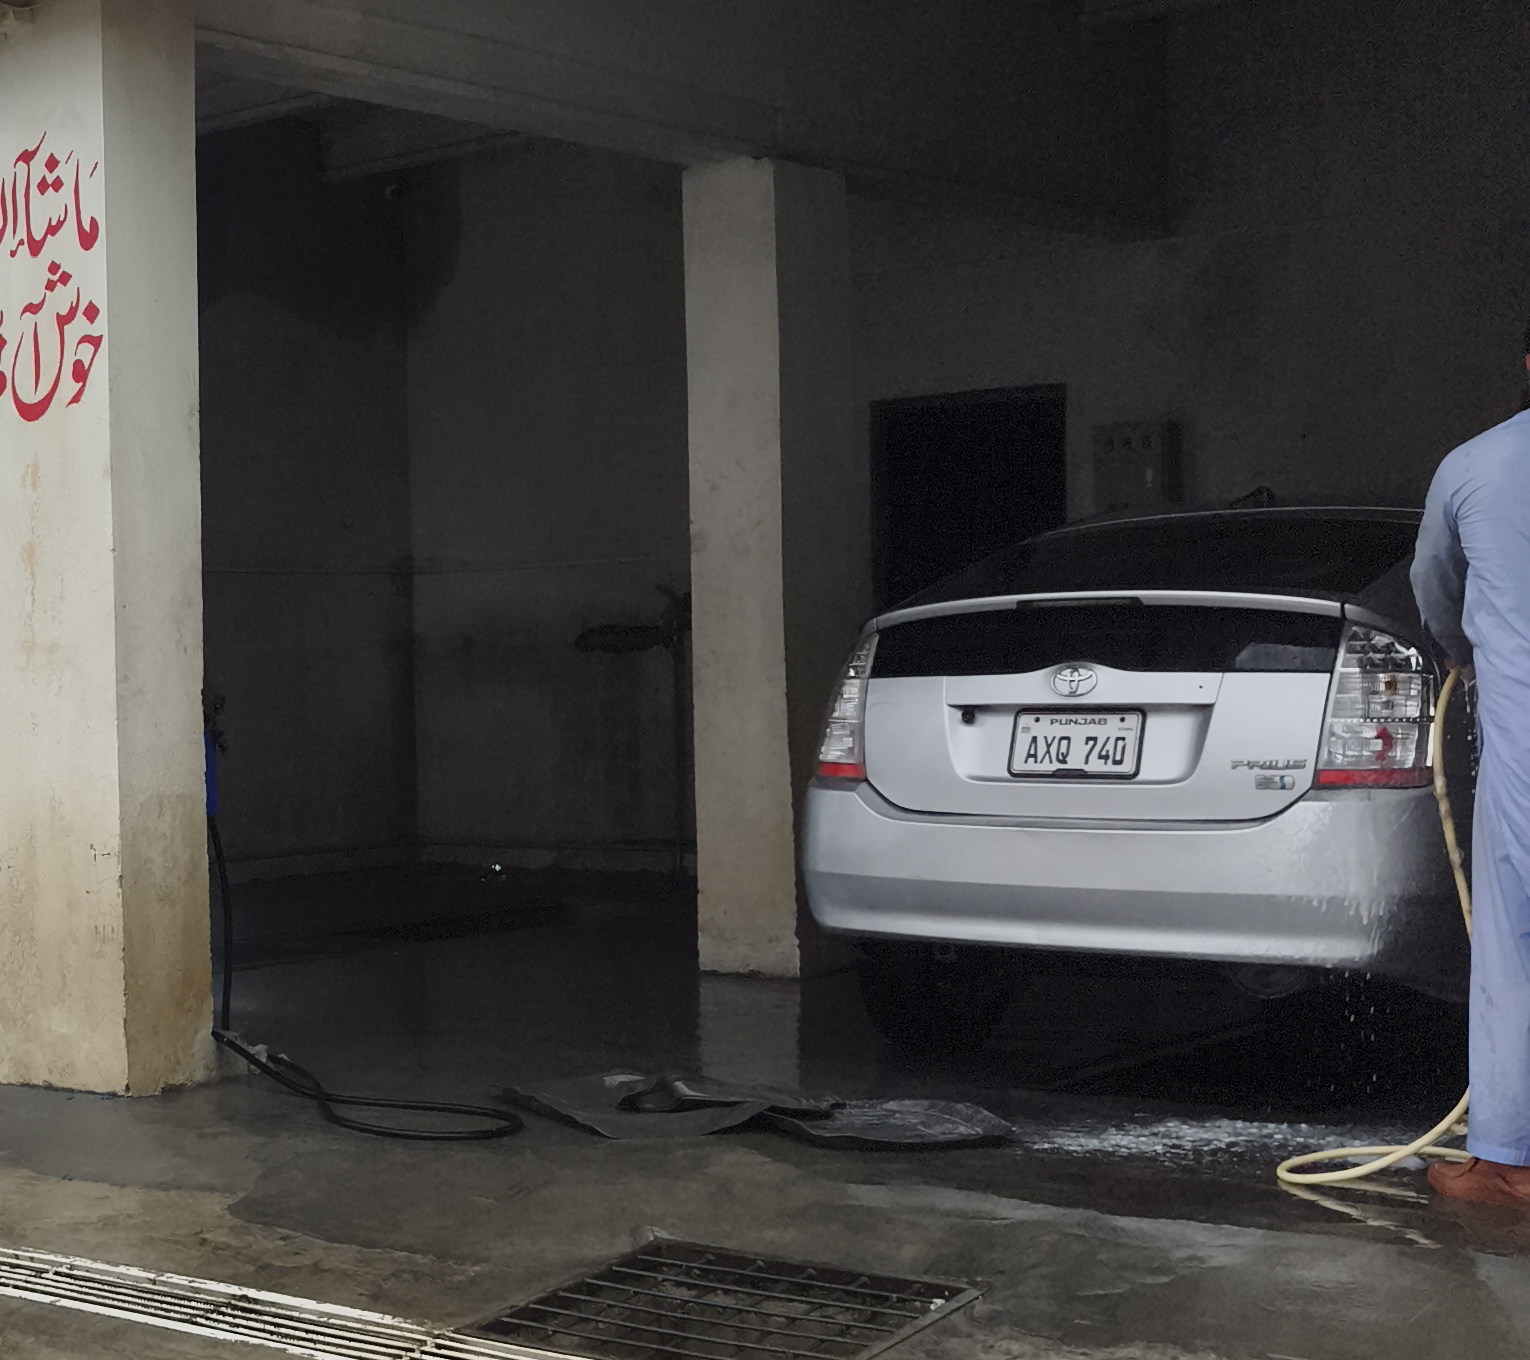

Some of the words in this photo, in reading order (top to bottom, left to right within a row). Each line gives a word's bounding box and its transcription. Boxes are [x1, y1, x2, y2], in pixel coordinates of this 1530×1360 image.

[11, 260, 104, 423] خوش
[1050, 717, 1108, 726] PUNJAB
[1023, 735, 1072, 765] AXQ
[1083, 736, 1127, 766] 740
